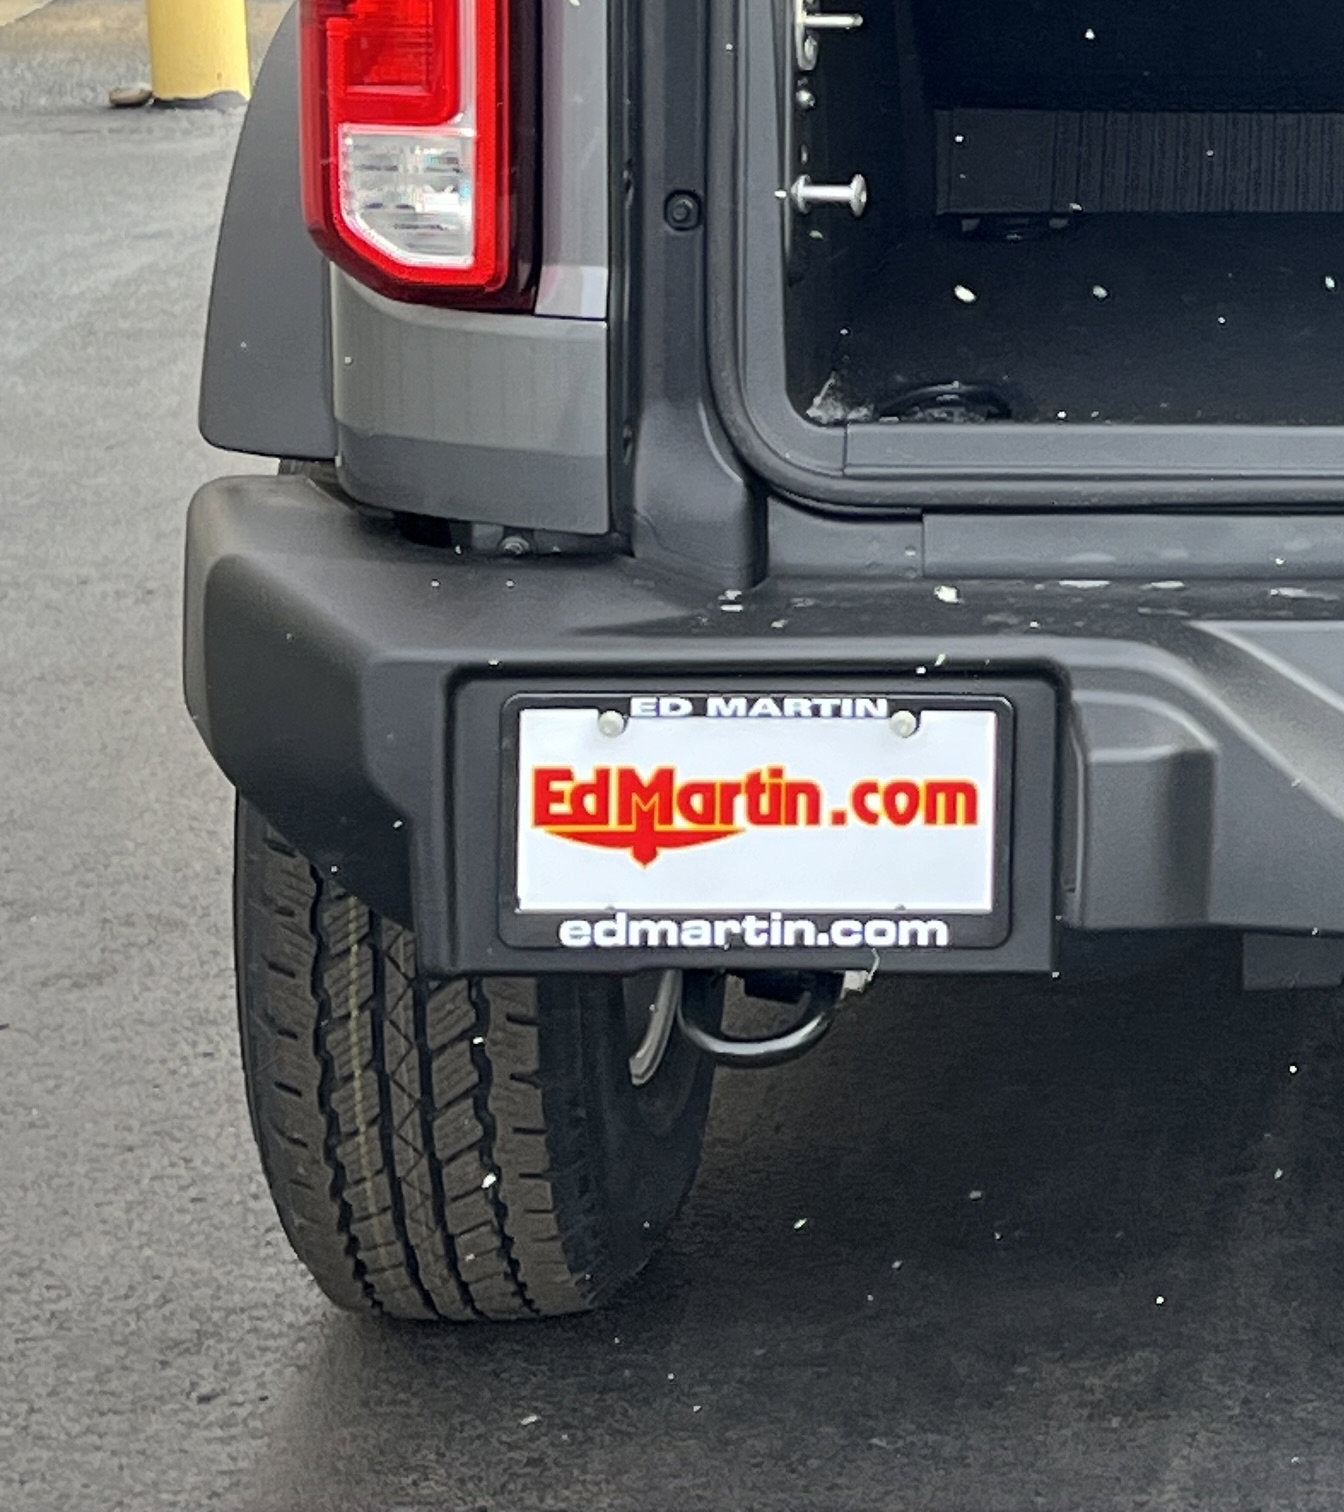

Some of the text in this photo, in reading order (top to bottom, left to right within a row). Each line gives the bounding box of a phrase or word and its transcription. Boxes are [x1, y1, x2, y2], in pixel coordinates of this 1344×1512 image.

[630, 697, 888, 719] ED MARTIN
[558, 912, 949, 948] edmartin.com
